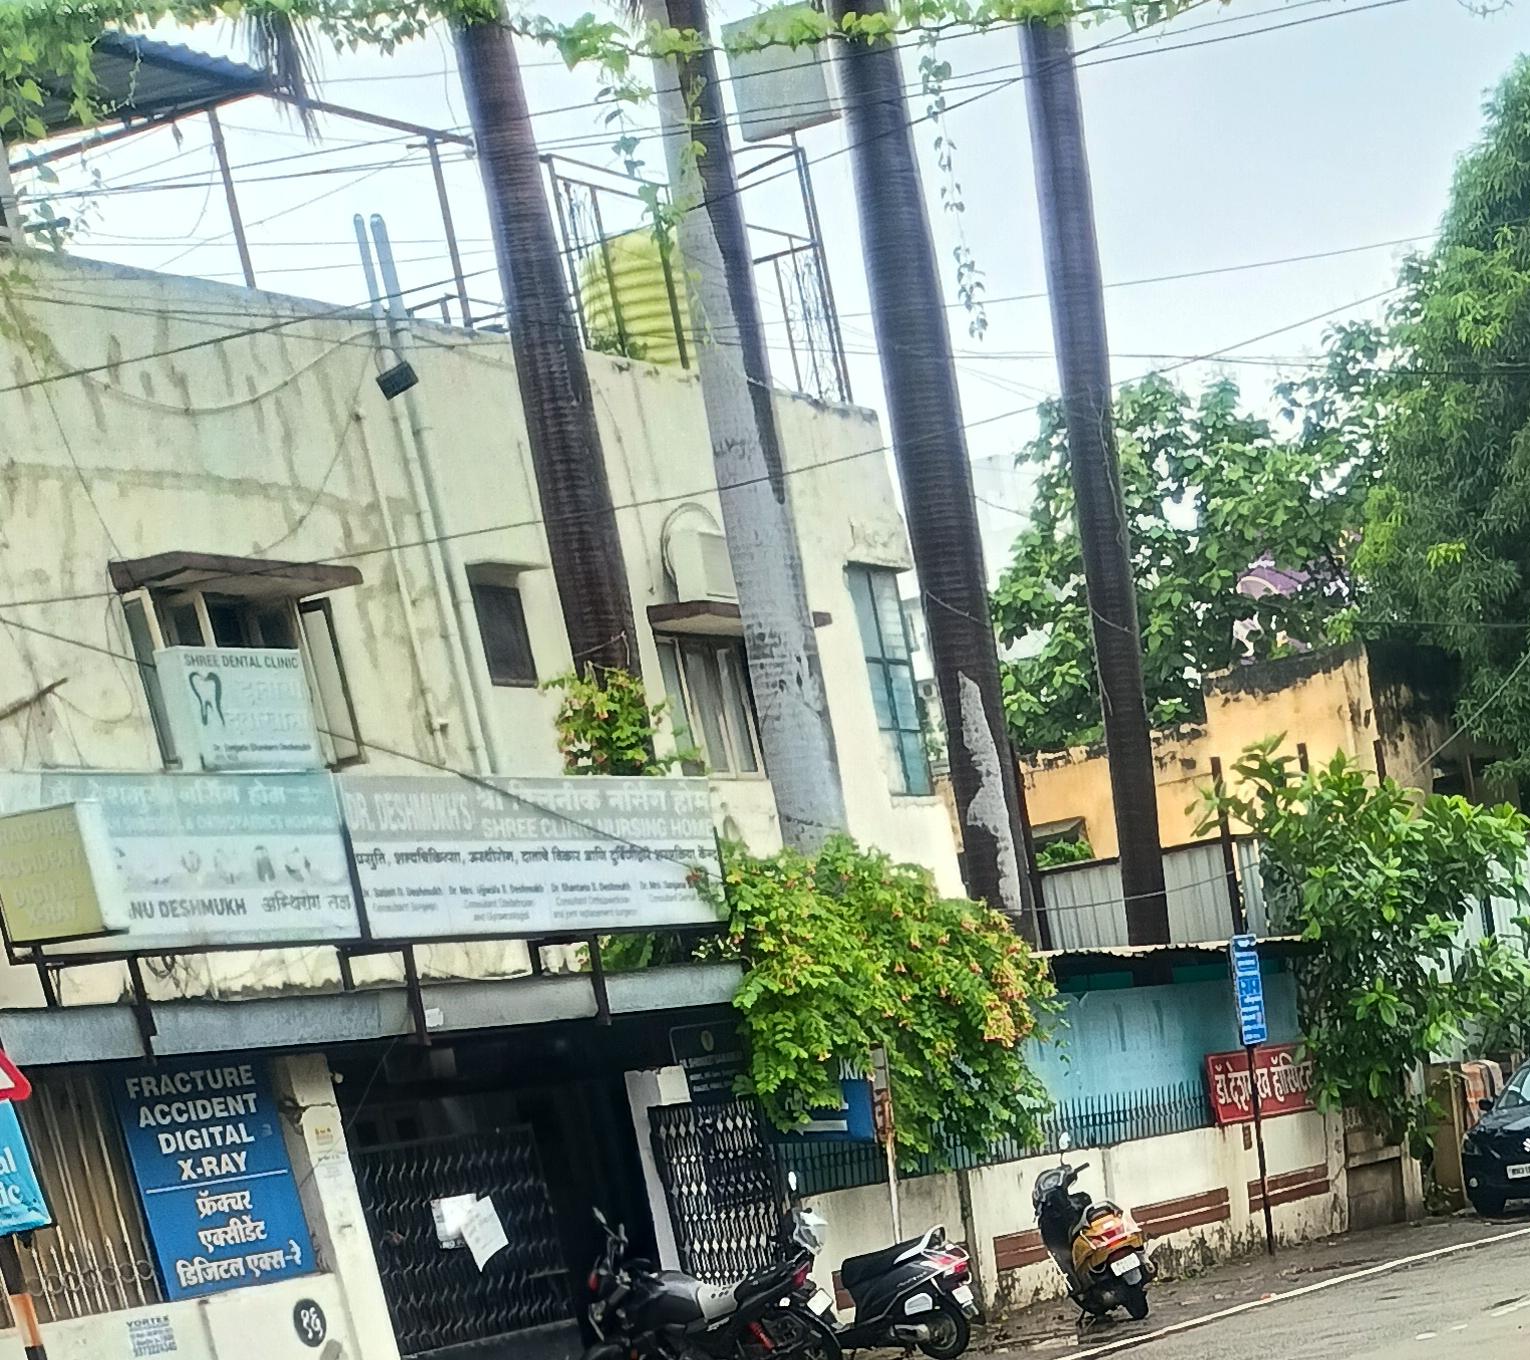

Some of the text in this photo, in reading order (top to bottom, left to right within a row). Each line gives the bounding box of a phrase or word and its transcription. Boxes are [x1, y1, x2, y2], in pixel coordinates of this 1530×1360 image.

[184, 654, 299, 669] SHREE DENTAL CLINIC
[481, 817, 538, 839] SHREE
[596, 817, 666, 838] NURSING
[671, 816, 714, 837] HOME
[159, 898, 247, 919] DESHMUKH
[125, 1064, 257, 1099] FRACTURE
[139, 1092, 258, 1129] ACCIDENT
[158, 1122, 256, 1155] DIGITAL
[178, 1151, 248, 1181] X-RAY
[176, 1256, 246, 1288] डिजिटल
[246, 1238, 303, 1278] एक्स-रे
